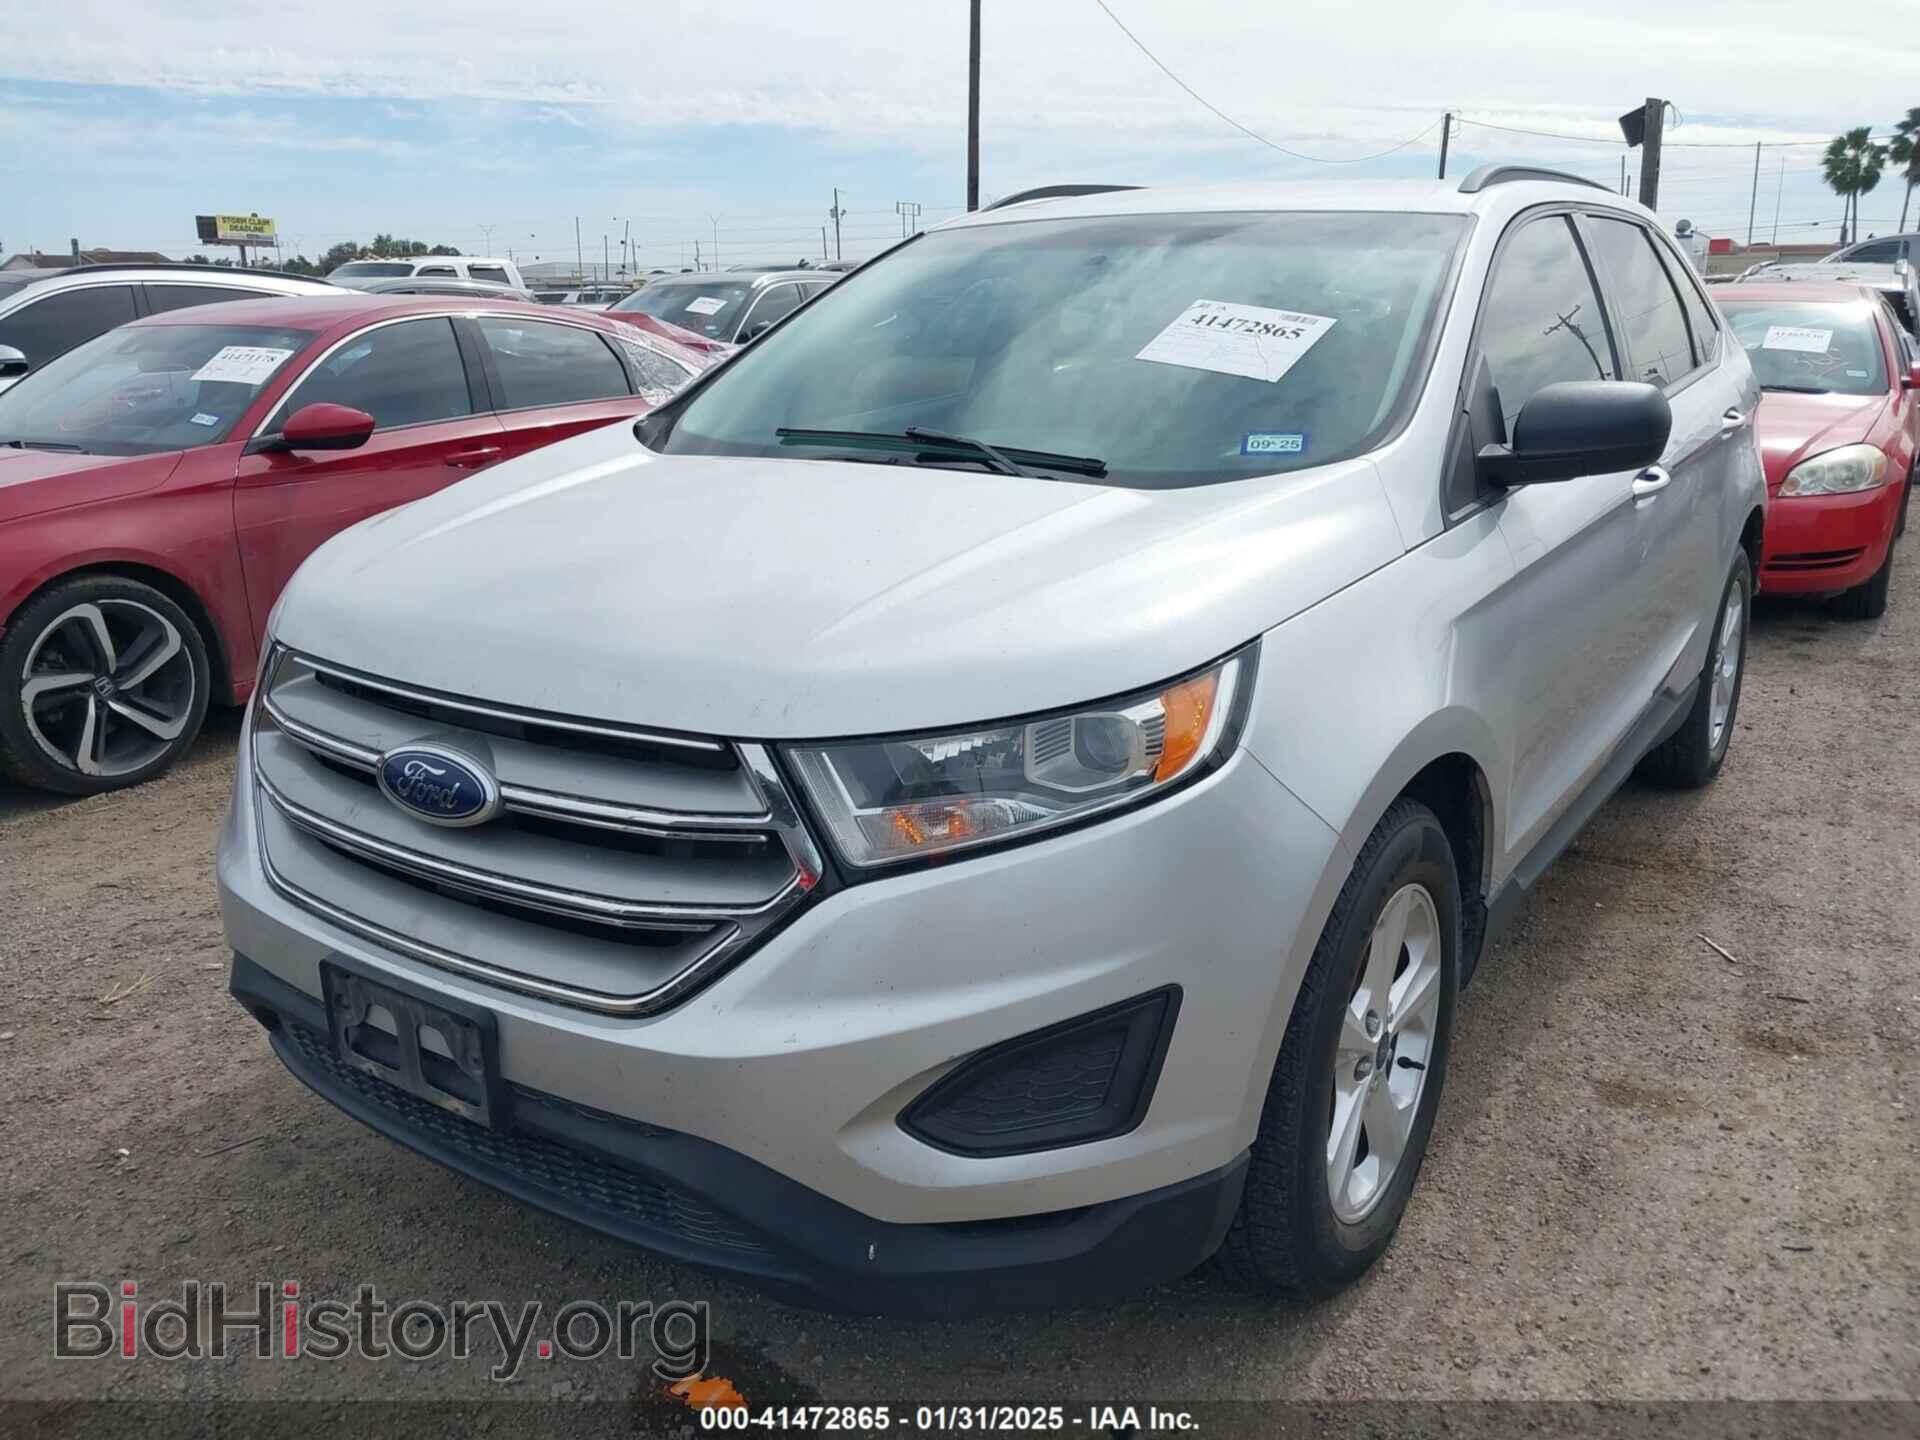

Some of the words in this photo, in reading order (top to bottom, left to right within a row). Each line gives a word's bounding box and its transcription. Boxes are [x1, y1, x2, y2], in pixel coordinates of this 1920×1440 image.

[229, 224, 264, 233] DEADLINE
[1191, 313, 1307, 341] 41472865
[1250, 439, 1271, 449] 09
[396, 760, 461, 809] Ford
